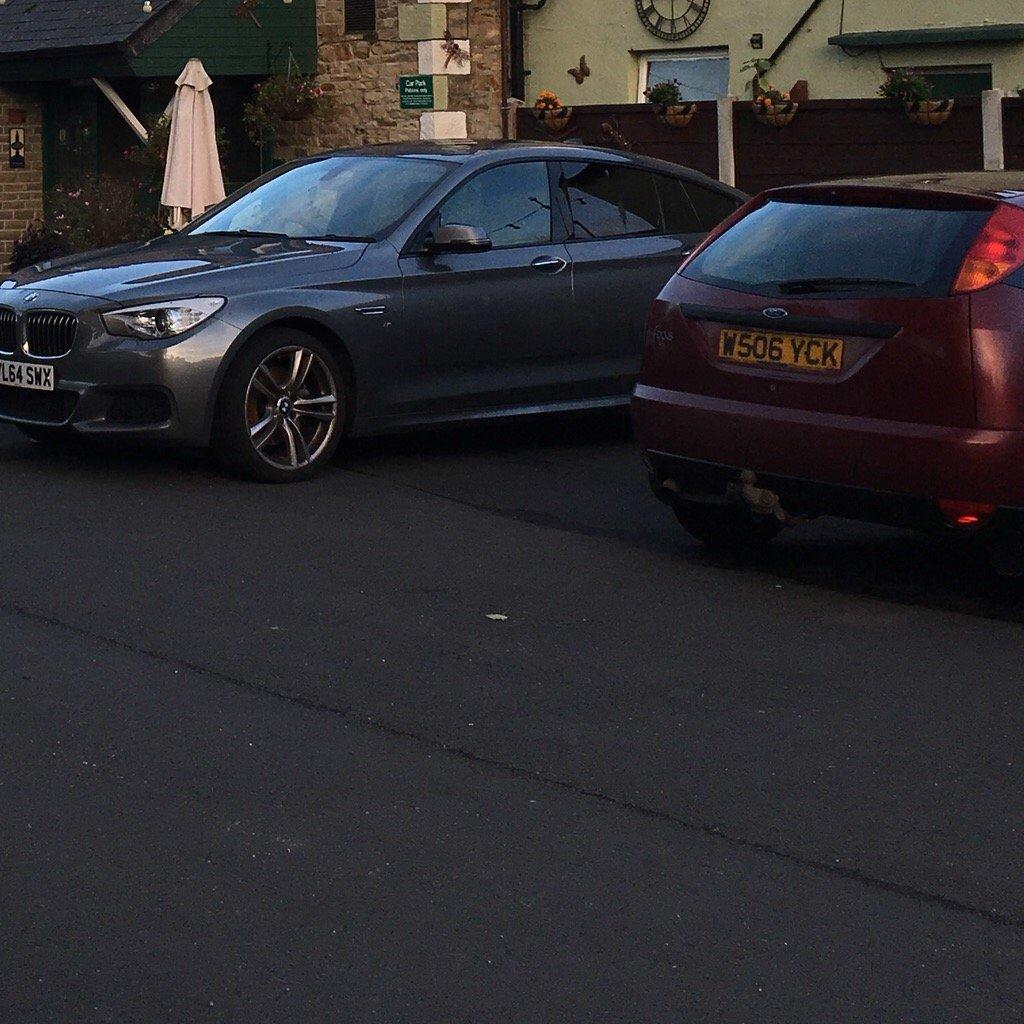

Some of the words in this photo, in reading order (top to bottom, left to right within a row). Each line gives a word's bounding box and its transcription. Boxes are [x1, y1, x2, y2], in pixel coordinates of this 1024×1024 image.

[415, 79, 426, 87] Park
[723, 330, 783, 361] W506
[791, 338, 838, 367] YCK
[26, 366, 51, 387] SWX
